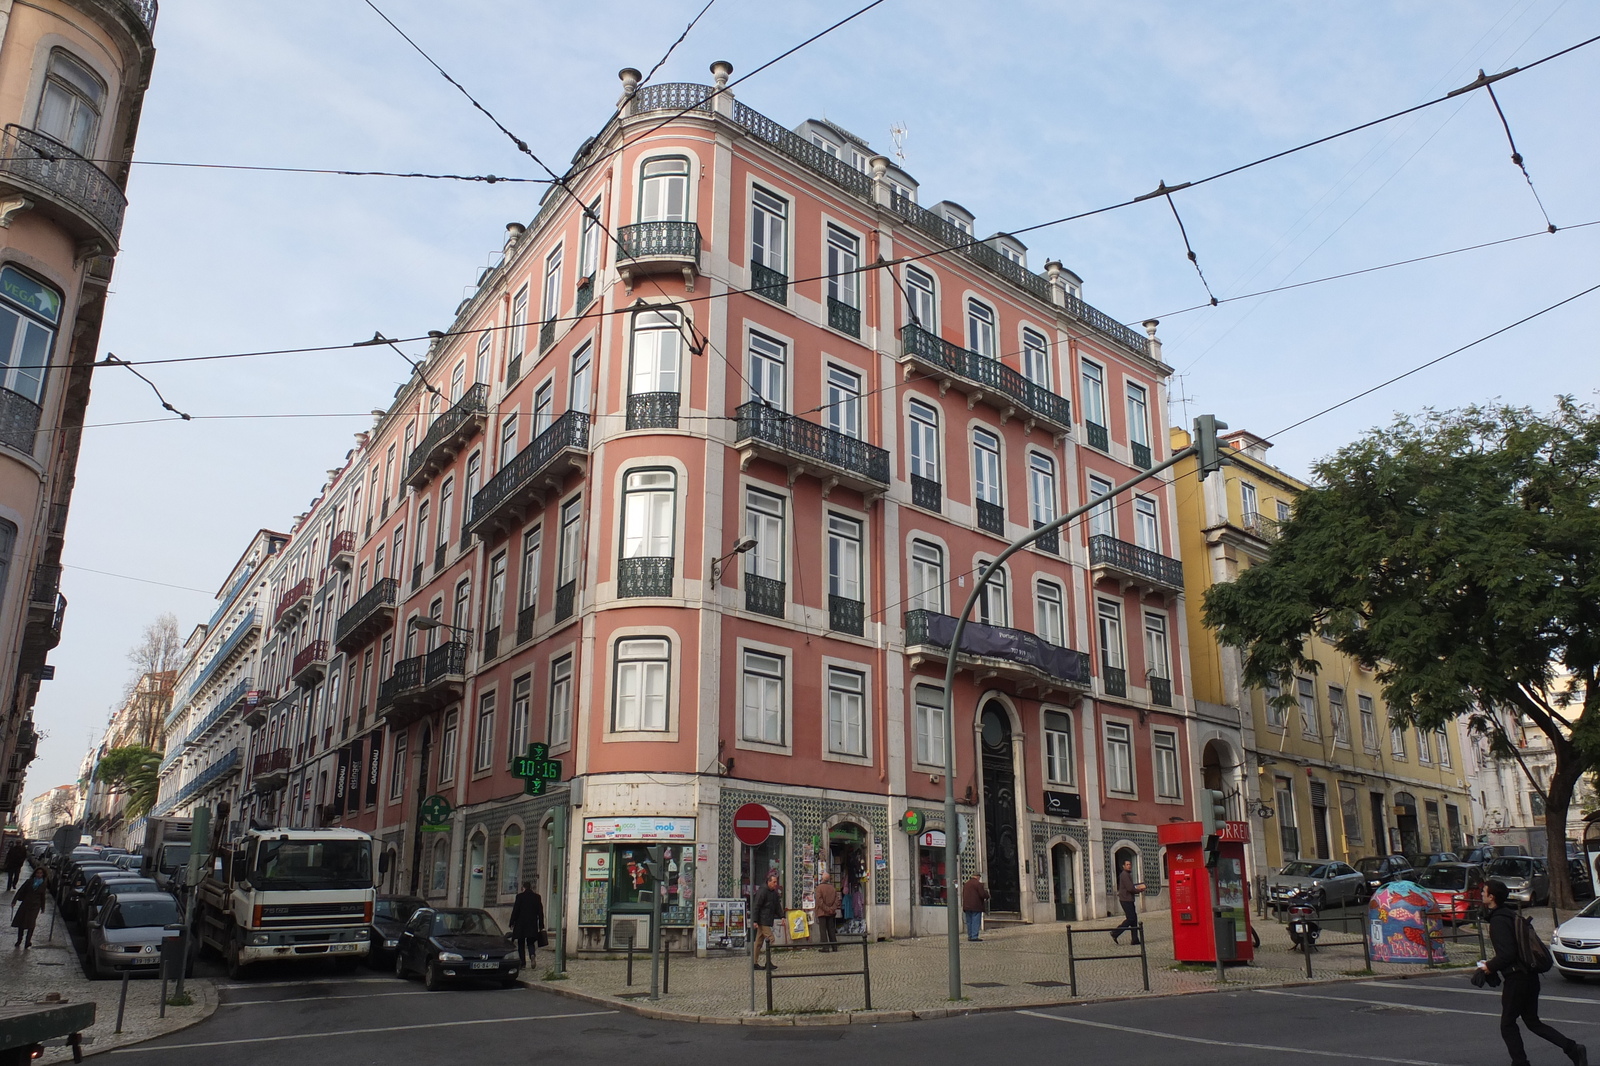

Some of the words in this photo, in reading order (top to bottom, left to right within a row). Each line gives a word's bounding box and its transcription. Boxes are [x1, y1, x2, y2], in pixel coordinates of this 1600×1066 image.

[4, 280, 35, 306] VEGA
[338, 766, 346, 798] GAGGENAU
[370, 750, 379, 785] GAGGENAU
[520, 760, 557, 778] 10:16
